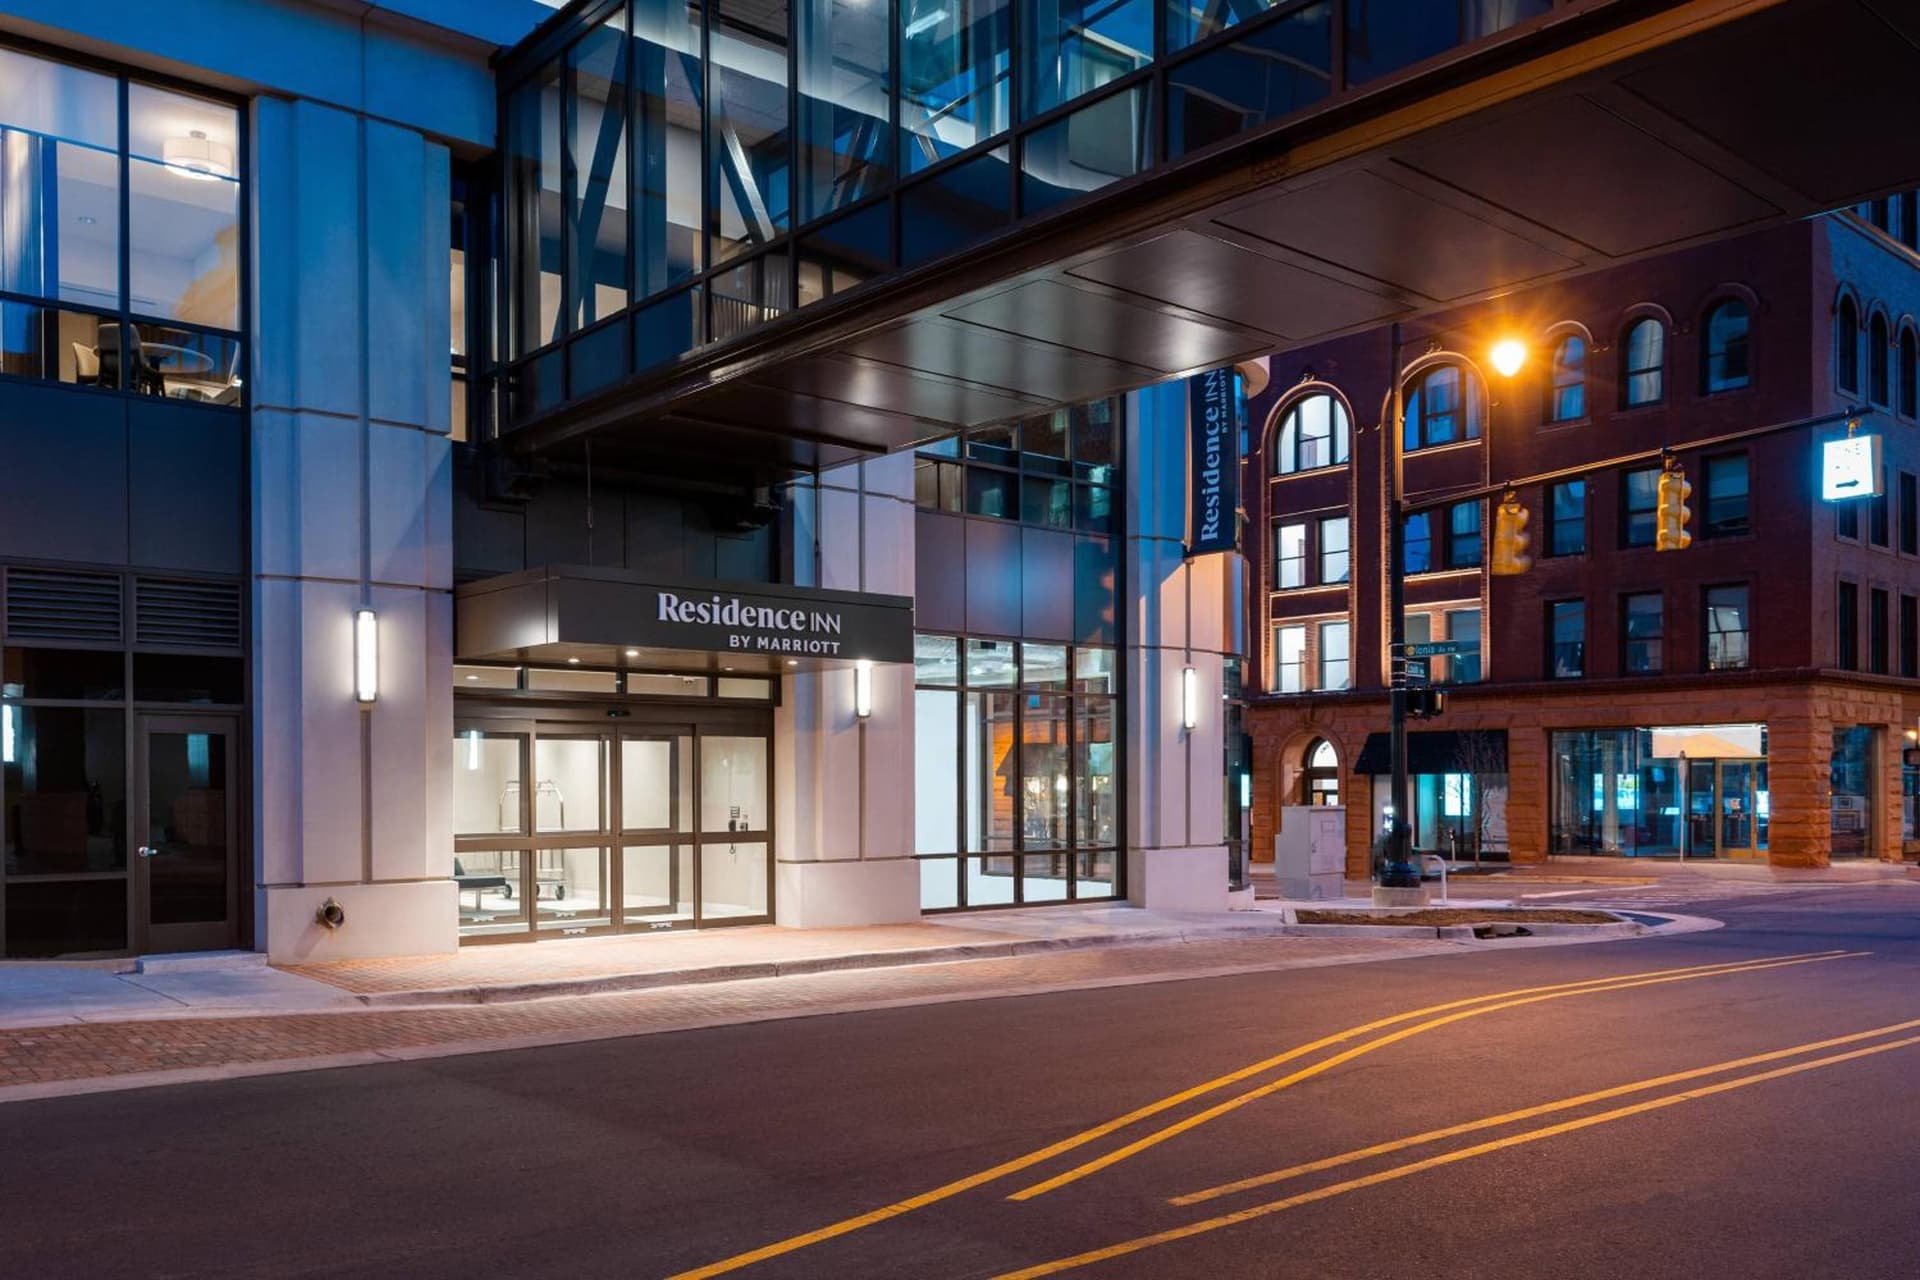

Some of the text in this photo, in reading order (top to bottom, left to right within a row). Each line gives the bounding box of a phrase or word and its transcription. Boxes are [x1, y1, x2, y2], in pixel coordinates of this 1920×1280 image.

[1219, 369, 1228, 433] BY MARRIOTT
[1201, 371, 1220, 541] Residence INN
[658, 592, 841, 634] Residence INN
[730, 635, 841, 654] BY MARRIOTT
